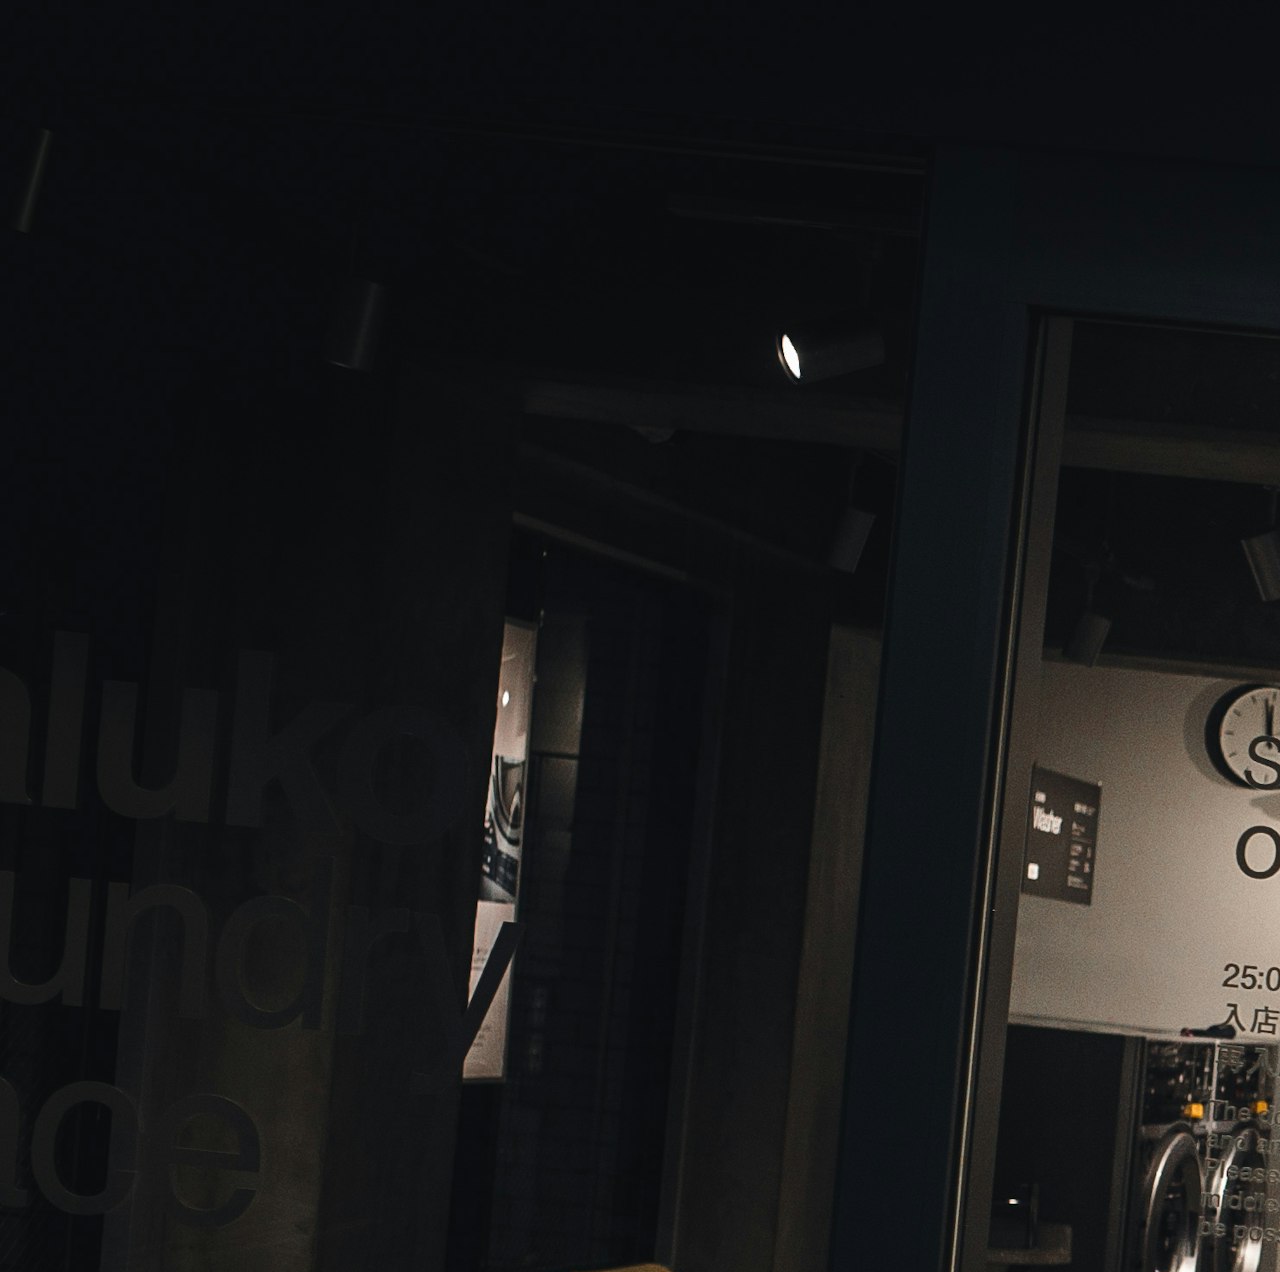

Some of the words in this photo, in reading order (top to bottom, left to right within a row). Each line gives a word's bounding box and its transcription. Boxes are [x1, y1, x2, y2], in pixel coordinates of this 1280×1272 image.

[0, 630, 470, 845] luko
[0, 1077, 264, 1228] ce
[1205, 1158, 1280, 1185] Please
[1199, 1215, 1227, 1237] be
